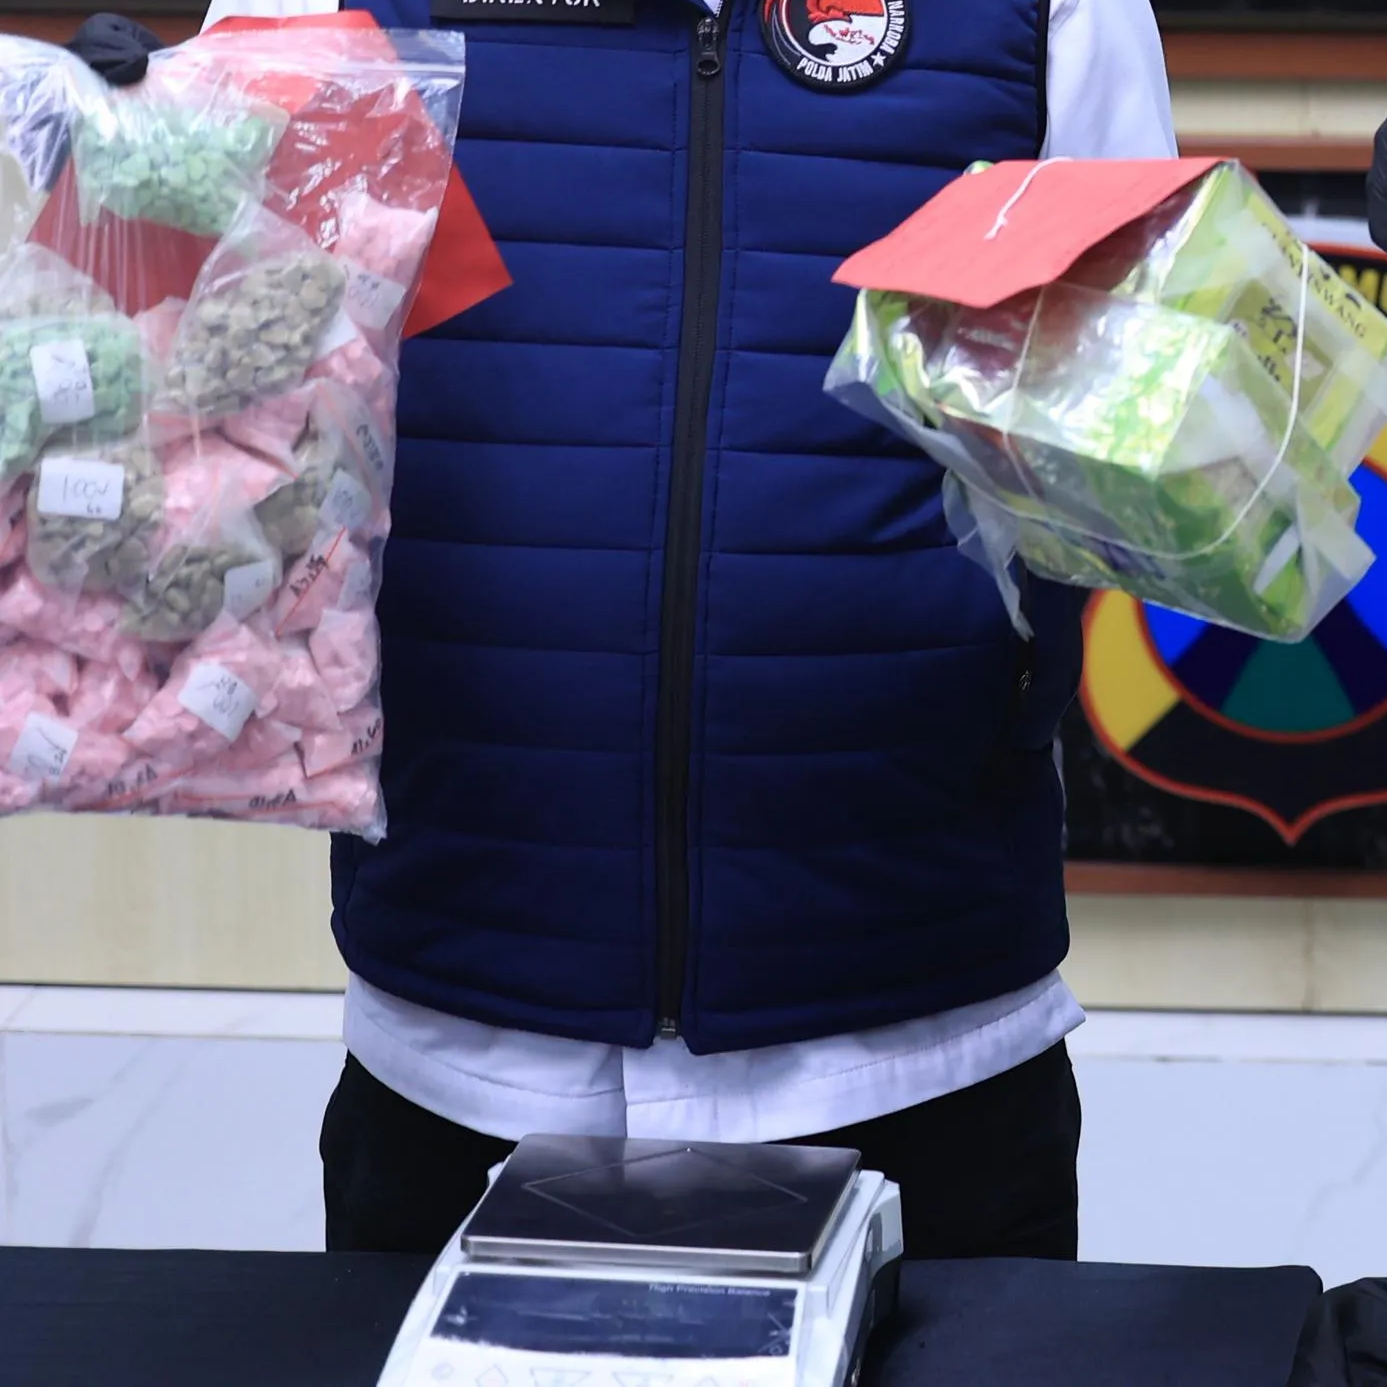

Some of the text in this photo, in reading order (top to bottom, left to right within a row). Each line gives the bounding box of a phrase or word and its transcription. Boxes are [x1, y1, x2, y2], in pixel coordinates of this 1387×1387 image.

[880, 0, 905, 54] NARKOBA
[796, 56, 874, 82] POLDA JATIM
